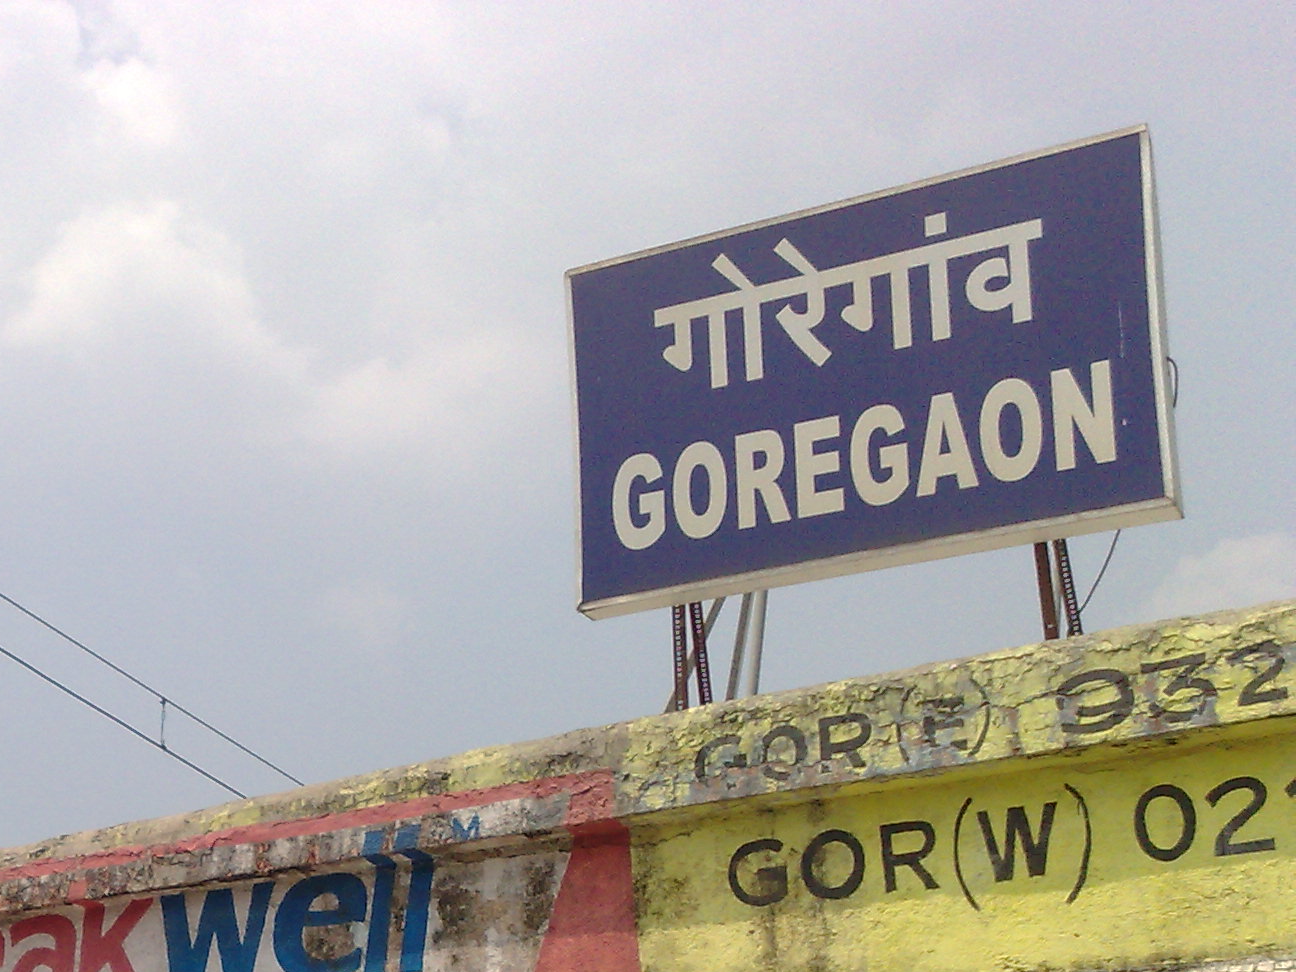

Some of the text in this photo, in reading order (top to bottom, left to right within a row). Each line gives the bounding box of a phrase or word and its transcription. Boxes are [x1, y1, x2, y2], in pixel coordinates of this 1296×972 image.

[654, 212, 1043, 390] गोरेगांव
[612, 360, 1117, 550] GOREGAON
[728, 776, 1296, 911] GOR(W) 02
